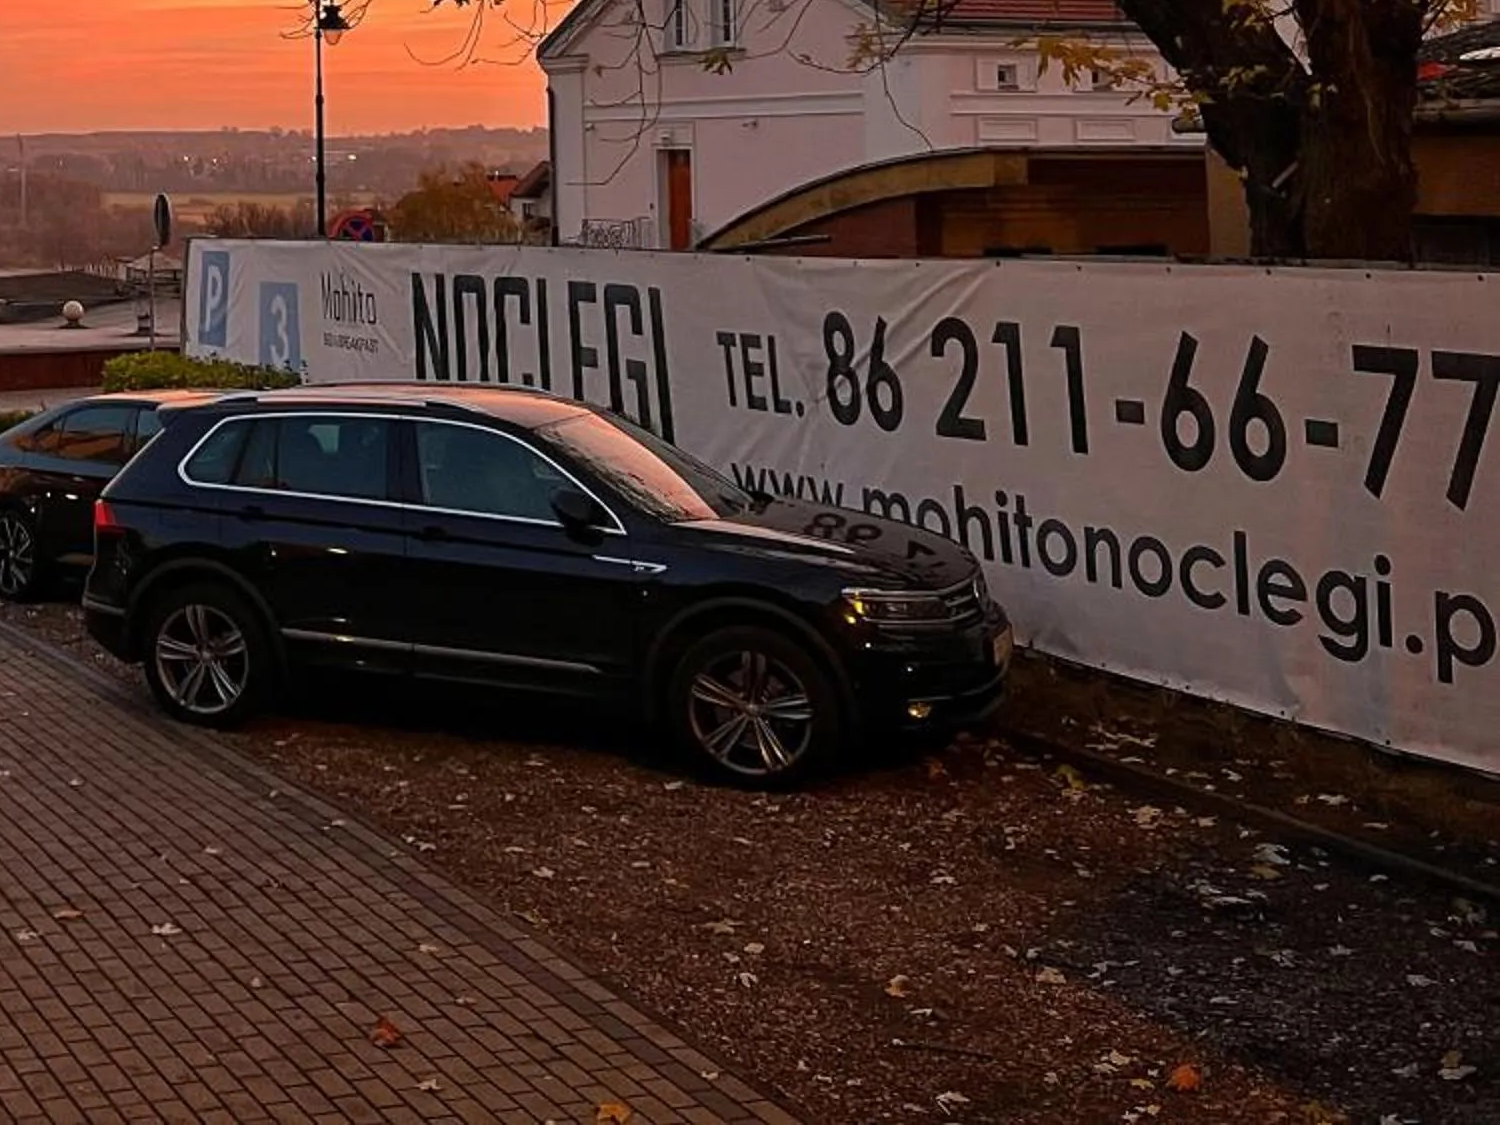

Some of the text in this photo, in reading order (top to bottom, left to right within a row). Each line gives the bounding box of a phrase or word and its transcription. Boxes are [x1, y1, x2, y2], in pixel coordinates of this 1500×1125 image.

[205, 265, 222, 332] P
[269, 295, 290, 370] 3
[321, 271, 377, 325] Mohito
[716, 311, 1500, 511] TEL. 86 211-66-77
